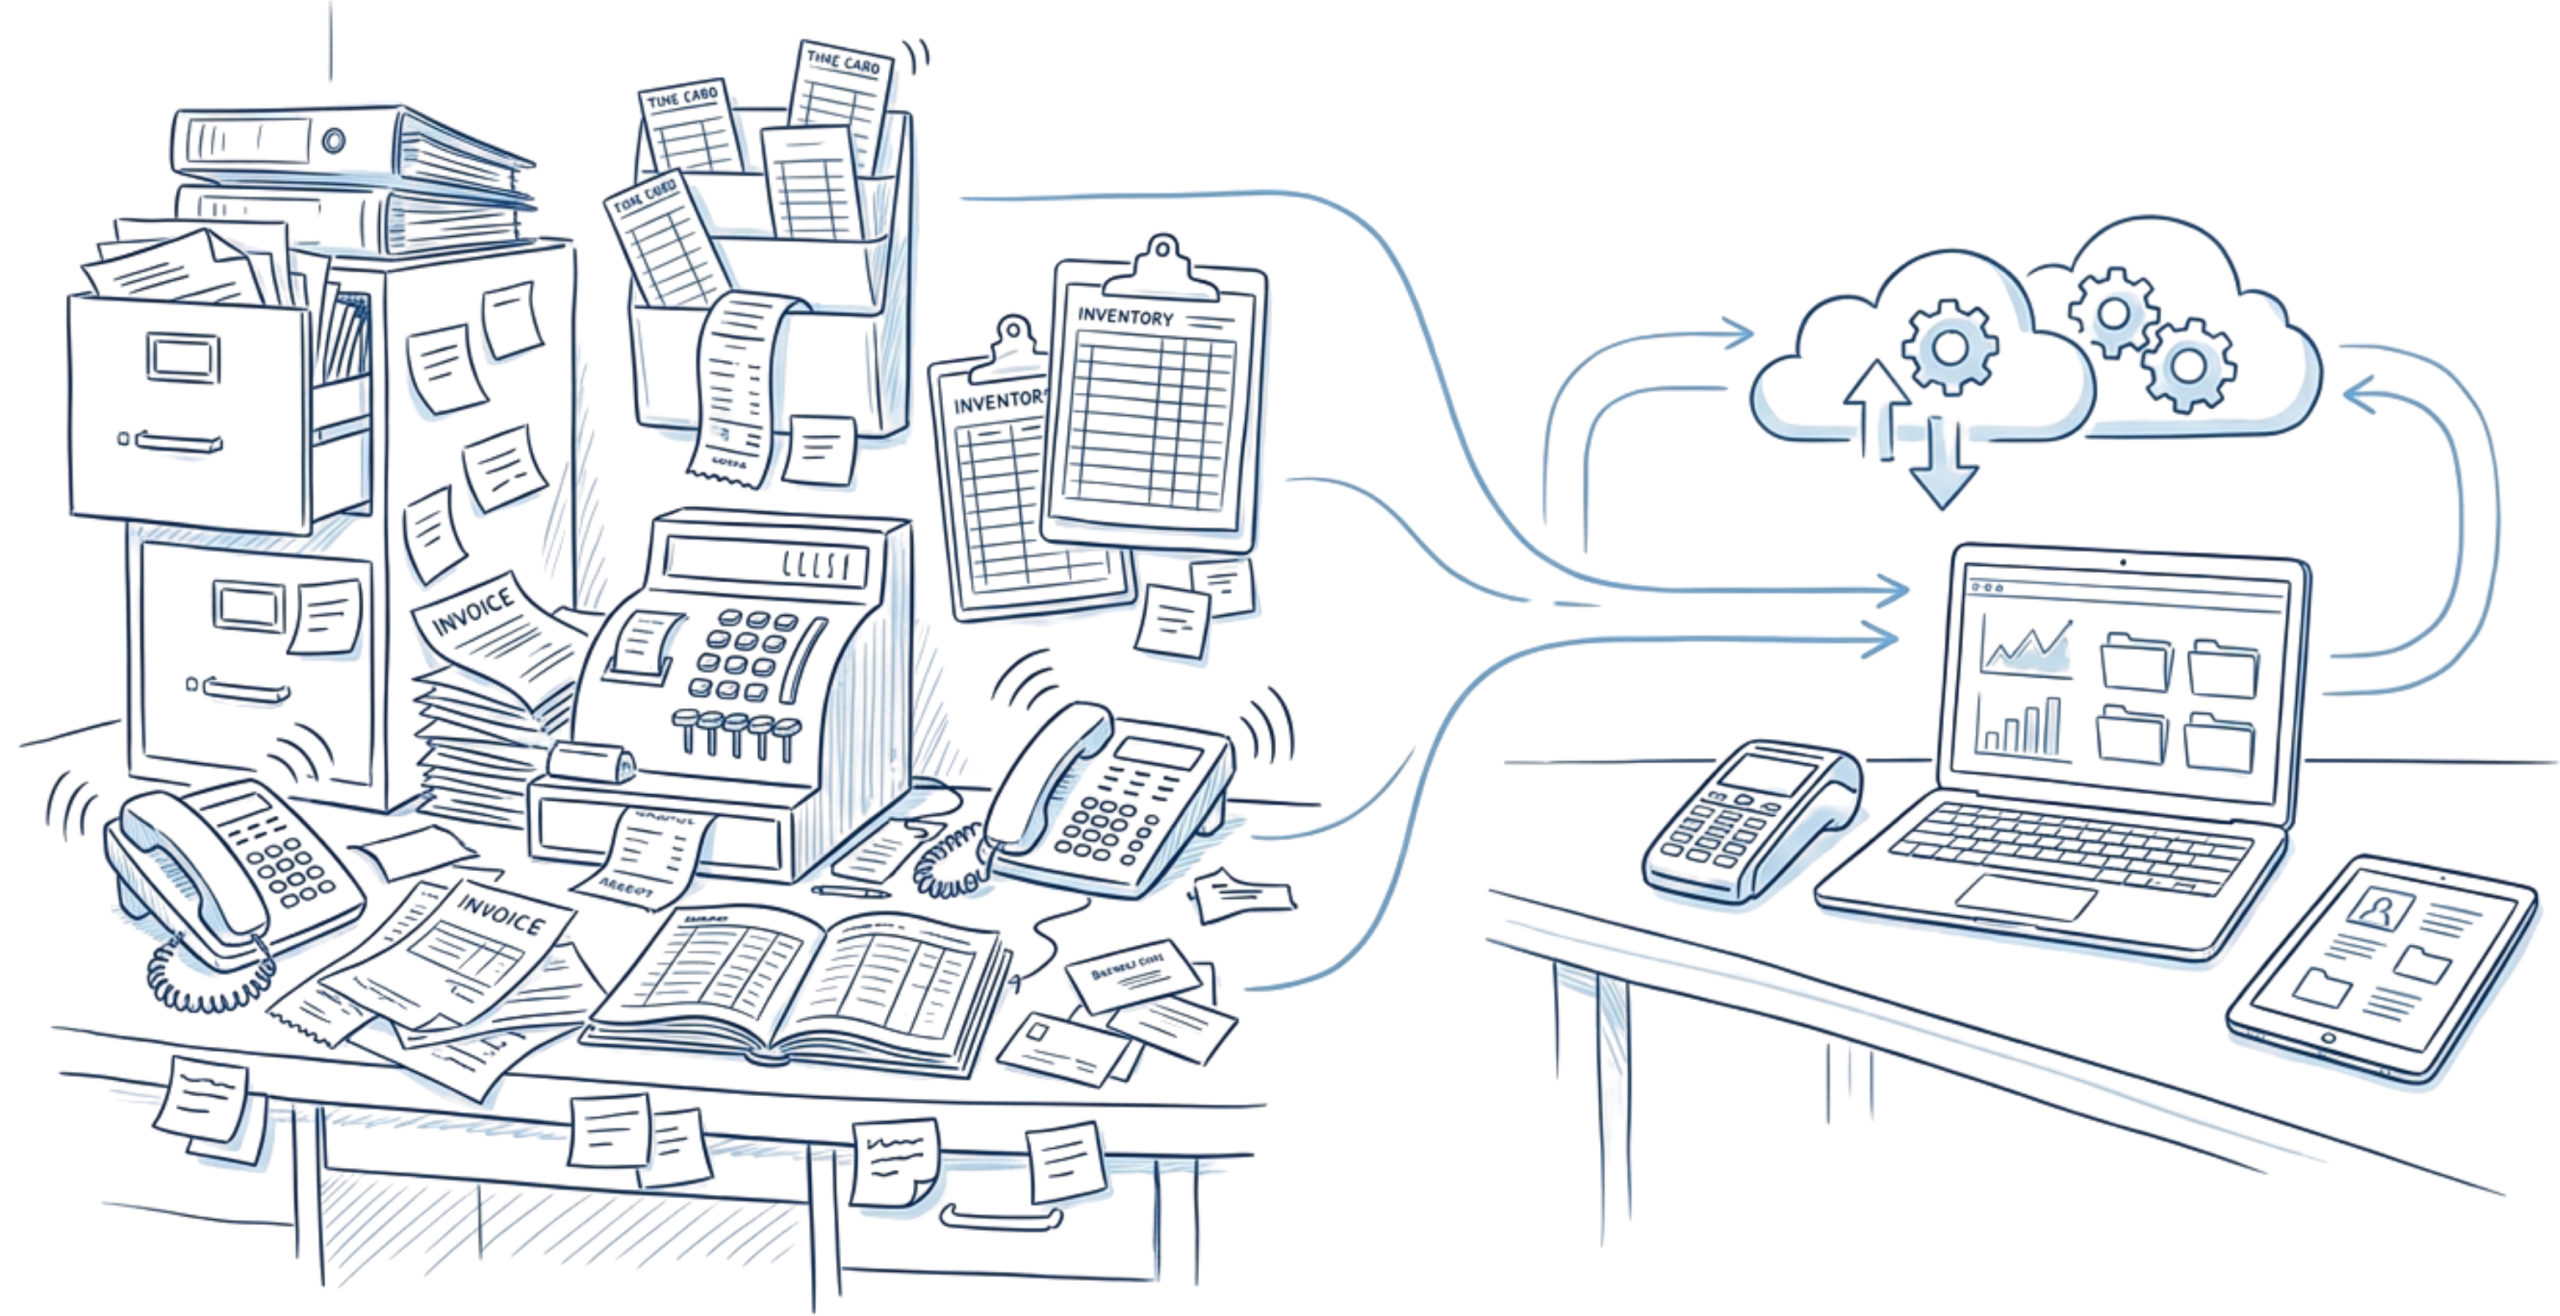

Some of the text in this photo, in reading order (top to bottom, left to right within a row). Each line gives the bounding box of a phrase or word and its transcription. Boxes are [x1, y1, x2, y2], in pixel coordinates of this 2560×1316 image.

[1078, 306, 1174, 327] INVENTORY
[954, 388, 1050, 415] INVENTOR
[432, 587, 515, 637] INVOICE
[457, 893, 546, 936] INVOICE
